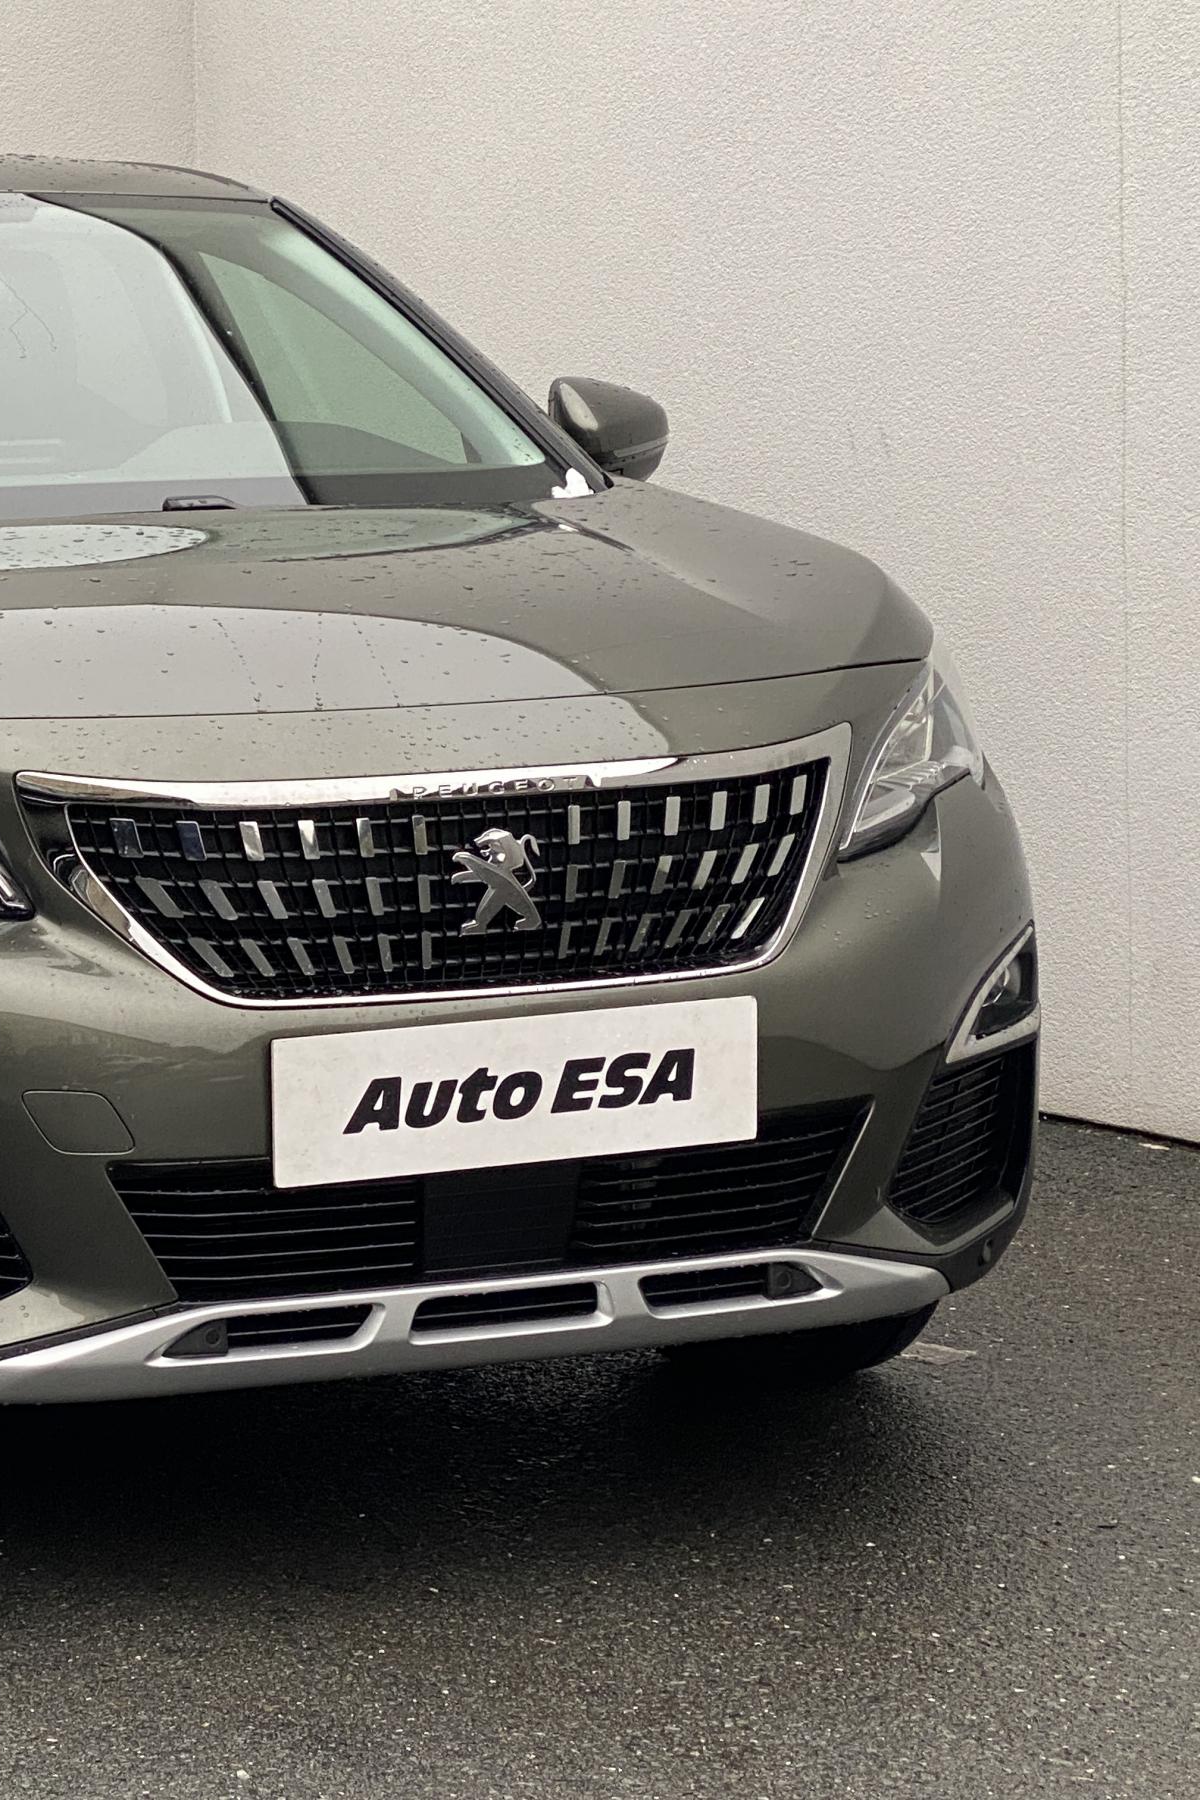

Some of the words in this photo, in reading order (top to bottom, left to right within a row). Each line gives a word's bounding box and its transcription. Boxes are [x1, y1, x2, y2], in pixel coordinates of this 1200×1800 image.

[412, 777, 578, 800] PEUGEOT
[343, 1066, 543, 1134] Auto
[550, 1048, 695, 1114] ESA
